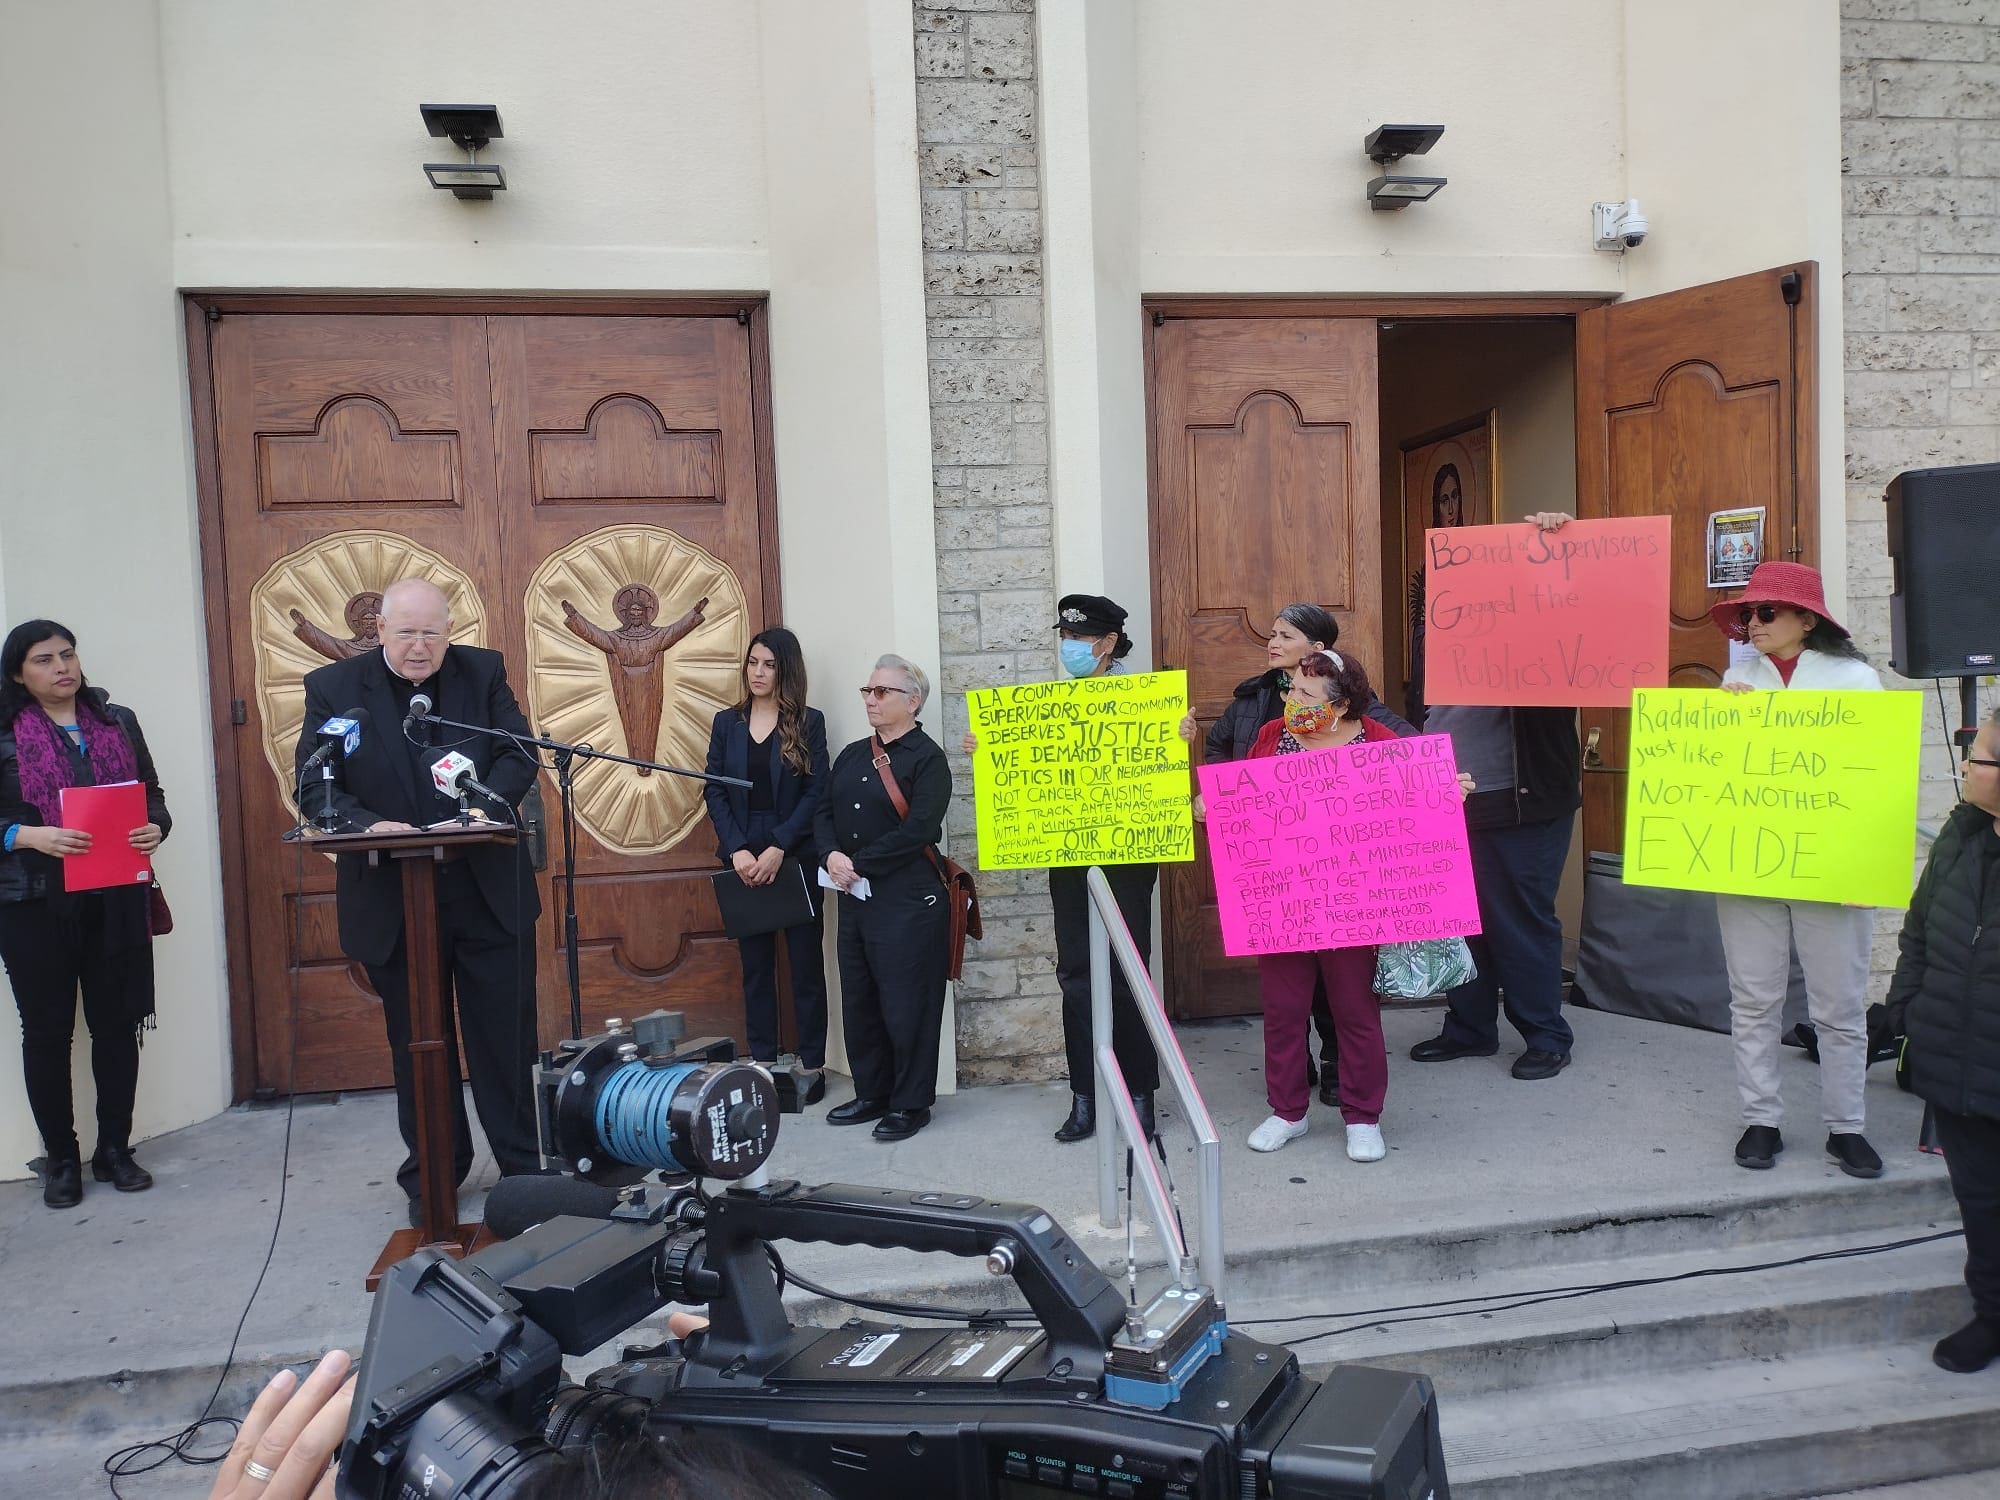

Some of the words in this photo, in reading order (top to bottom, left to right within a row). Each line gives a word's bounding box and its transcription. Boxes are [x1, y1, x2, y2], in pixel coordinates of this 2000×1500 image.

[1430, 533, 1512, 570] Board
[1526, 531, 1658, 580] Supervisors
[1431, 584, 1516, 636] Gagged
[1529, 584, 1580, 613] the
[1558, 634, 1655, 689] Voice
[976, 689, 1002, 709] LA
[1012, 682, 1078, 703] COUNTY
[1084, 678, 1133, 693] BOARD
[1140, 676, 1158, 688] OF
[979, 702, 1080, 727] SUPERVISORS
[1086, 700, 1117, 716] OUR
[1119, 696, 1183, 715] COMMUNITY
[1637, 692, 1740, 732] Radiation
[1749, 706, 1761, 718] is
[1761, 691, 1862, 728] Invisible
[986, 724, 1065, 745] DESERVES
[1070, 721, 1173, 748] JUSTICE
[991, 750, 1019, 769] WE
[1031, 745, 1101, 763] DEMAND
[1112, 747, 1168, 764] FIBER
[1215, 768, 1260, 796] LA
[1274, 751, 1340, 783] COUNTY
[1350, 741, 1414, 769] BOARD
[1421, 738, 1445, 758] OF
[1636, 740, 1676, 767] just
[1684, 741, 1724, 766] like
[1744, 742, 1826, 777] LEAD
[995, 769, 1052, 787] OPTICS
[1059, 769, 1075, 785] IN
[1080, 765, 1112, 785] OUR
[1117, 761, 1189, 780] NEIGHBORHOODS
[1213, 774, 1349, 818] SUPERVISORS
[1361, 767, 1391, 786] WE
[1396, 759, 1457, 790] VOTED
[993, 789, 1020, 810] NOT
[1027, 787, 1085, 802] CANCER
[1090, 783, 1152, 801] CAUSING
[994, 812, 1019, 826] FAST
[1026, 806, 1073, 818] TRACK
[994, 825, 1019, 841] WITH
[1028, 824, 1036, 834] A
[1042, 814, 1123, 833] MINISTERIAL
[1131, 809, 1182, 824] COUNTY
[1220, 818, 1256, 838] FOR
[1263, 803, 1307, 836] YOU
[1315, 796, 1348, 817] TO
[1353, 790, 1416, 814] SERVE
[1426, 791, 1457, 815] US
[993, 850, 1051, 865] DESERVES
[1056, 848, 1117, 862] PROTECTION
[1128, 838, 1189, 860] RESPECT!
[1064, 829, 1101, 850] OUR
[1112, 825, 1192, 848] COMMUNITY
[1226, 838, 1272, 862] NOT
[1286, 835, 1318, 854] TO
[1330, 817, 1417, 845] RUBBER
[1639, 816, 1820, 879] EXIDE
[1233, 866, 1293, 888] STAMP
[1300, 855, 1340, 877] WITH
[1349, 850, 1361, 868] A
[1368, 838, 1464, 865] MINISTERIAL
[1240, 881, 1291, 902] PERMIT
[1301, 877, 1328, 892] TO
[1336, 870, 1369, 887] GET
[1379, 858, 1454, 884] INSTALLED
[1242, 900, 1272, 922] 5G
[1281, 892, 1358, 919] WIRELESS
[1368, 882, 1447, 903] ANTENNAS
[1249, 921, 1272, 935] ON
[1282, 914, 1317, 932] OUR
[1262, 932, 1325, 950] VIOLATE
[1330, 923, 1386, 942] CEQA
[1008, 1450, 1026, 1461] HOLD
[1035, 1455, 1066, 1468] COUNTER
[1076, 1463, 1095, 1474] RESET
[1101, 1469, 1131, 1481] MONITOR
[1167, 1483, 1188, 1493] LIGHT
